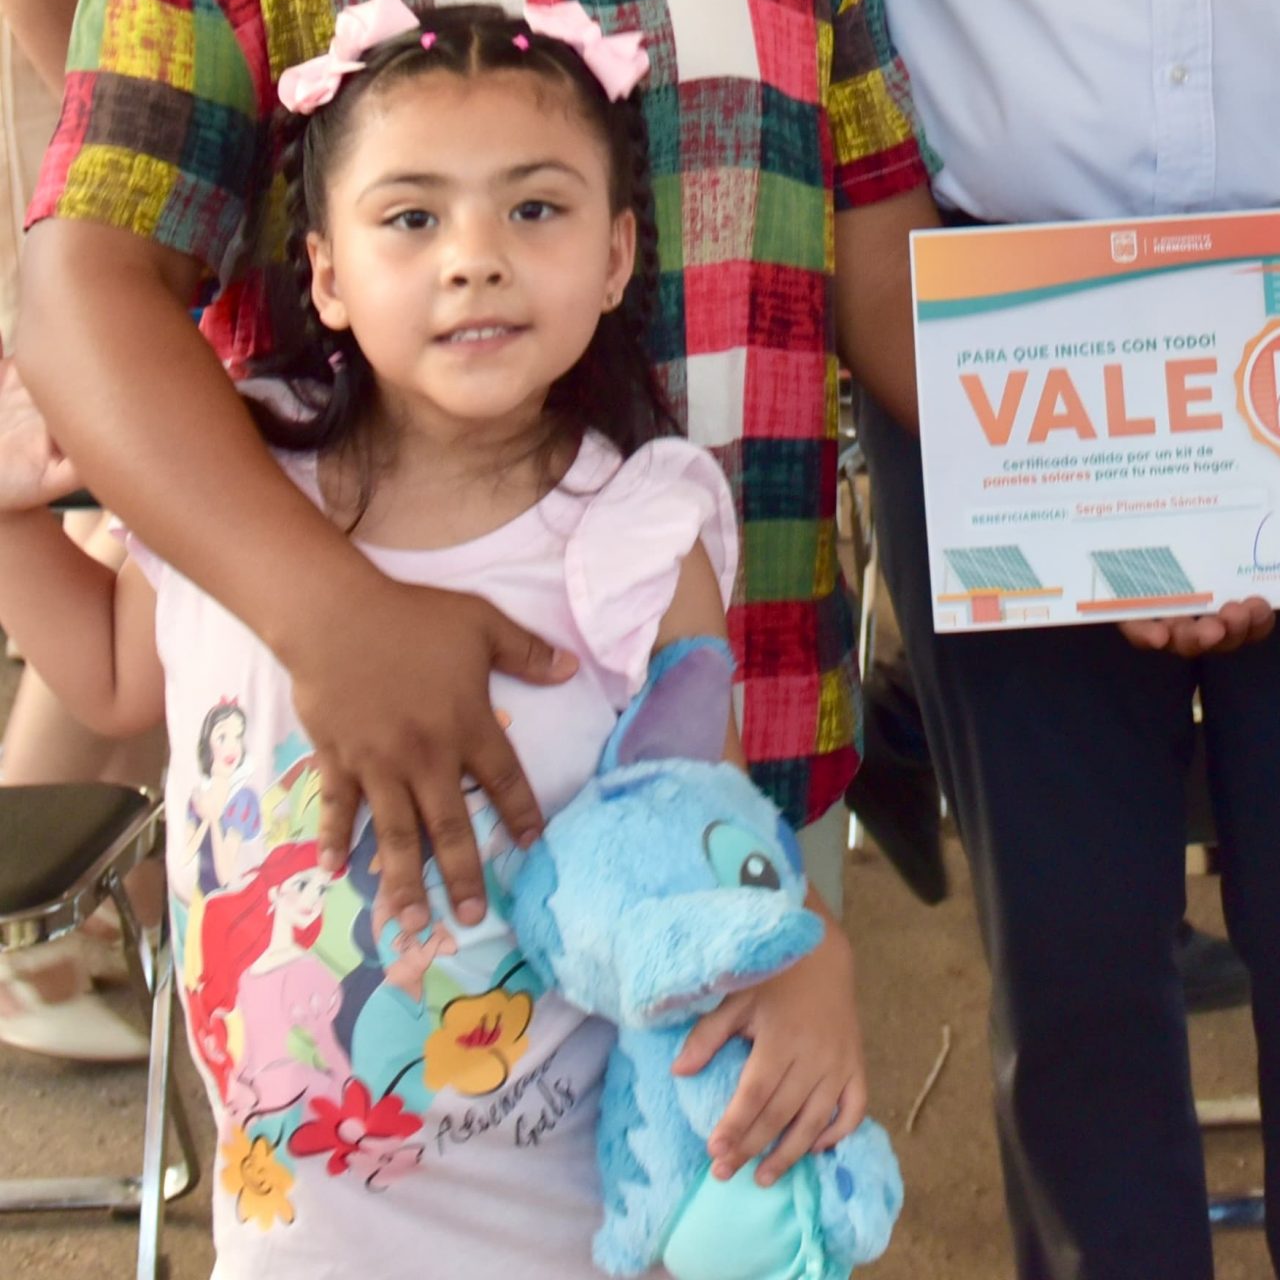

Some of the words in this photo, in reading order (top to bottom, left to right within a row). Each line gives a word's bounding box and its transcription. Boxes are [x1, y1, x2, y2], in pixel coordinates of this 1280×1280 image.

[957, 350, 1008, 368] ¡PARA
[1013, 344, 1049, 362] QUE
[1055, 341, 1116, 357] INICIES
[1121, 337, 1157, 353] CON
[1163, 332, 1217, 351] TODO!
[959, 357, 1224, 447] VALE
[1003, 453, 1078, 471] Certificado
[1082, 449, 1123, 467] válido
[1127, 450, 1151, 465] por
[1155, 450, 1172, 461] un
[1176, 446, 1193, 460] kit
[1197, 445, 1214, 458] de
[983, 472, 1037, 489] paneles
[1041, 468, 1091, 484] solares
[1095, 468, 1128, 483] para
[1132, 465, 1146, 478] tu
[1150, 465, 1190, 477] nuevo
[1075, 500, 1113, 517] Sergio
[1170, 494, 1219, 508] Sánchez
